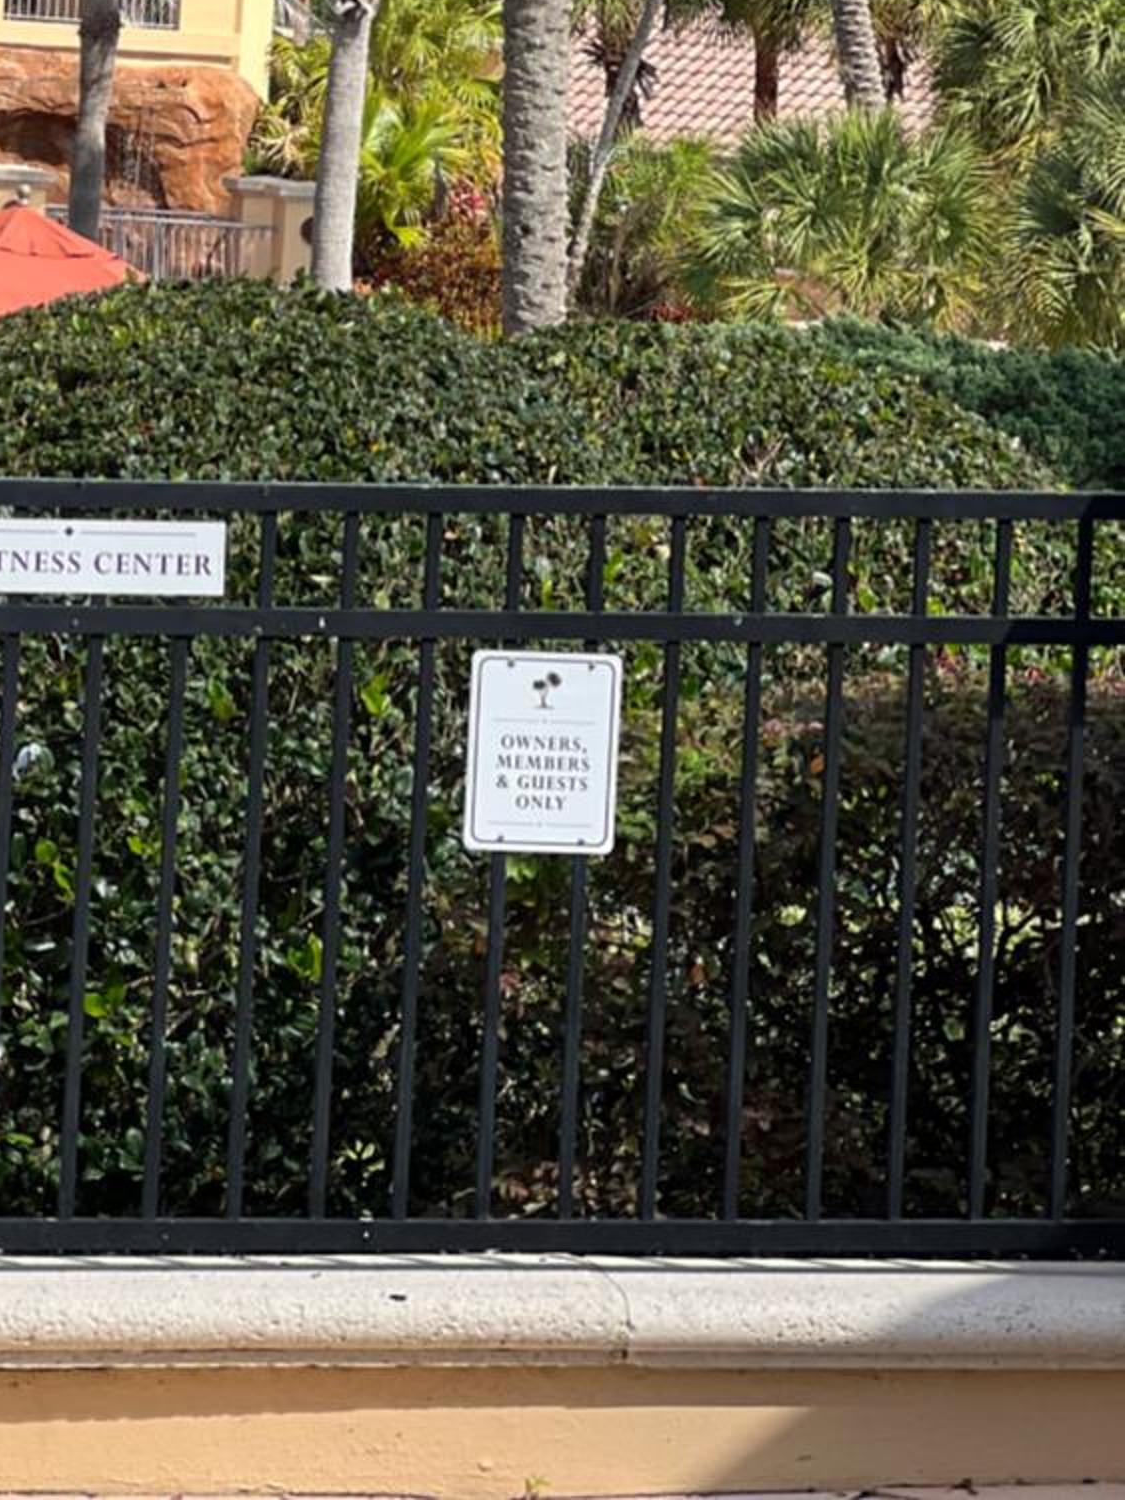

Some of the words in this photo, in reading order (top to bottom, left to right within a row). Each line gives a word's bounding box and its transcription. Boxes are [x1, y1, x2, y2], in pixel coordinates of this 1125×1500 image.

[94, 552, 212, 576] CENTER
[501, 734, 587, 753] OWNERS,
[497, 754, 591, 772] MEMBERS
[495, 774, 508, 789] &
[517, 775, 588, 791] GUESTS
[515, 794, 567, 811] ONLY
